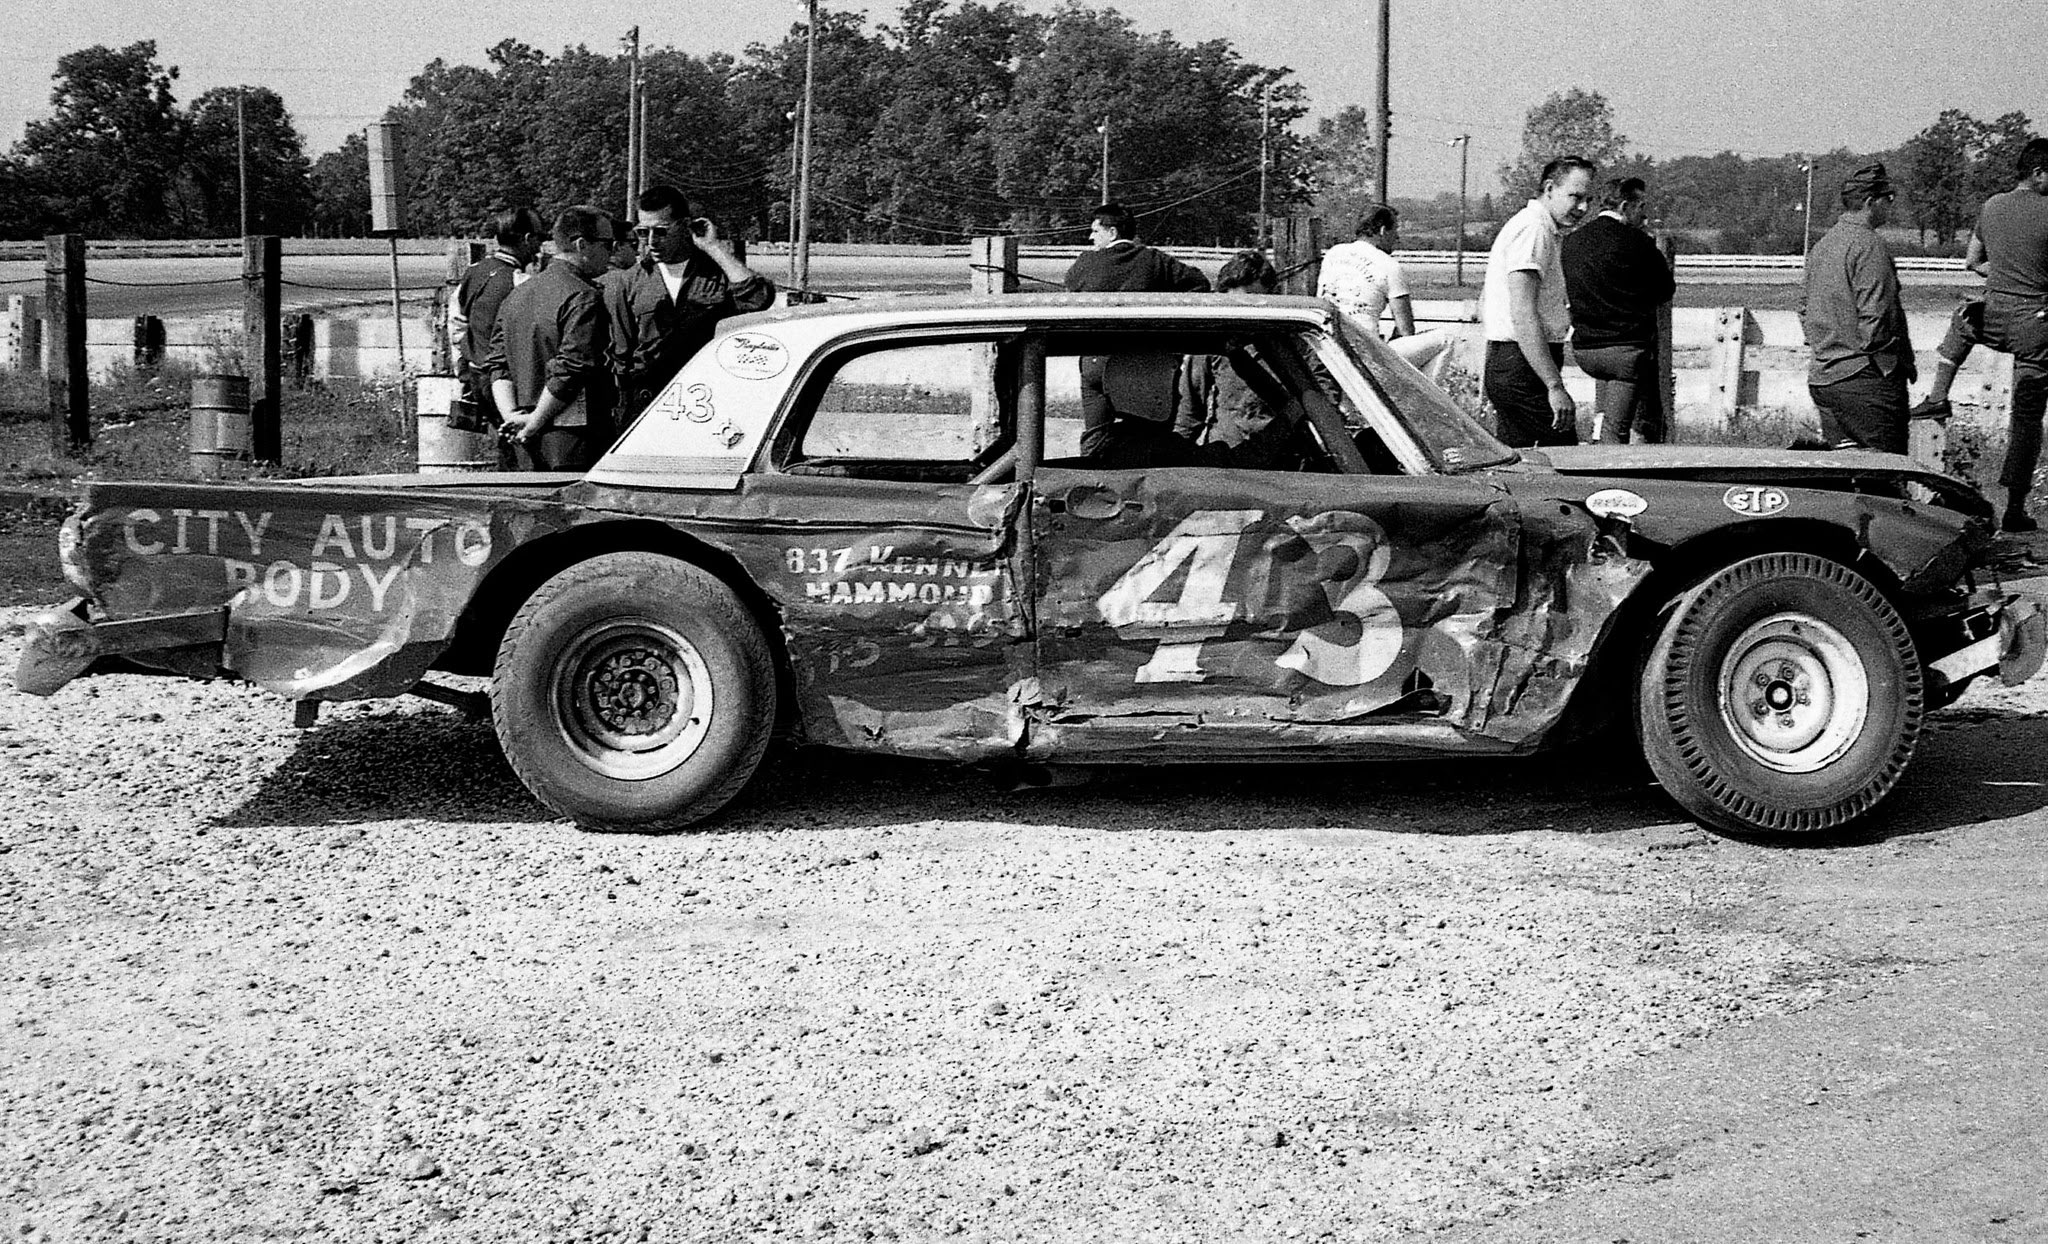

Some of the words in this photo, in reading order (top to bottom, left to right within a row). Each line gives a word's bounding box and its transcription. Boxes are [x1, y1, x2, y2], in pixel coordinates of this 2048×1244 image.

[656, 382, 715, 424] 43
[1733, 487, 1782, 513] STP
[124, 508, 273, 557] CITY
[311, 513, 493, 567] AUTO
[786, 547, 852, 574] 837
[224, 557, 404, 612] BODY
[806, 581, 993, 605] HAMMOND
[1097, 509, 1403, 686] 43
